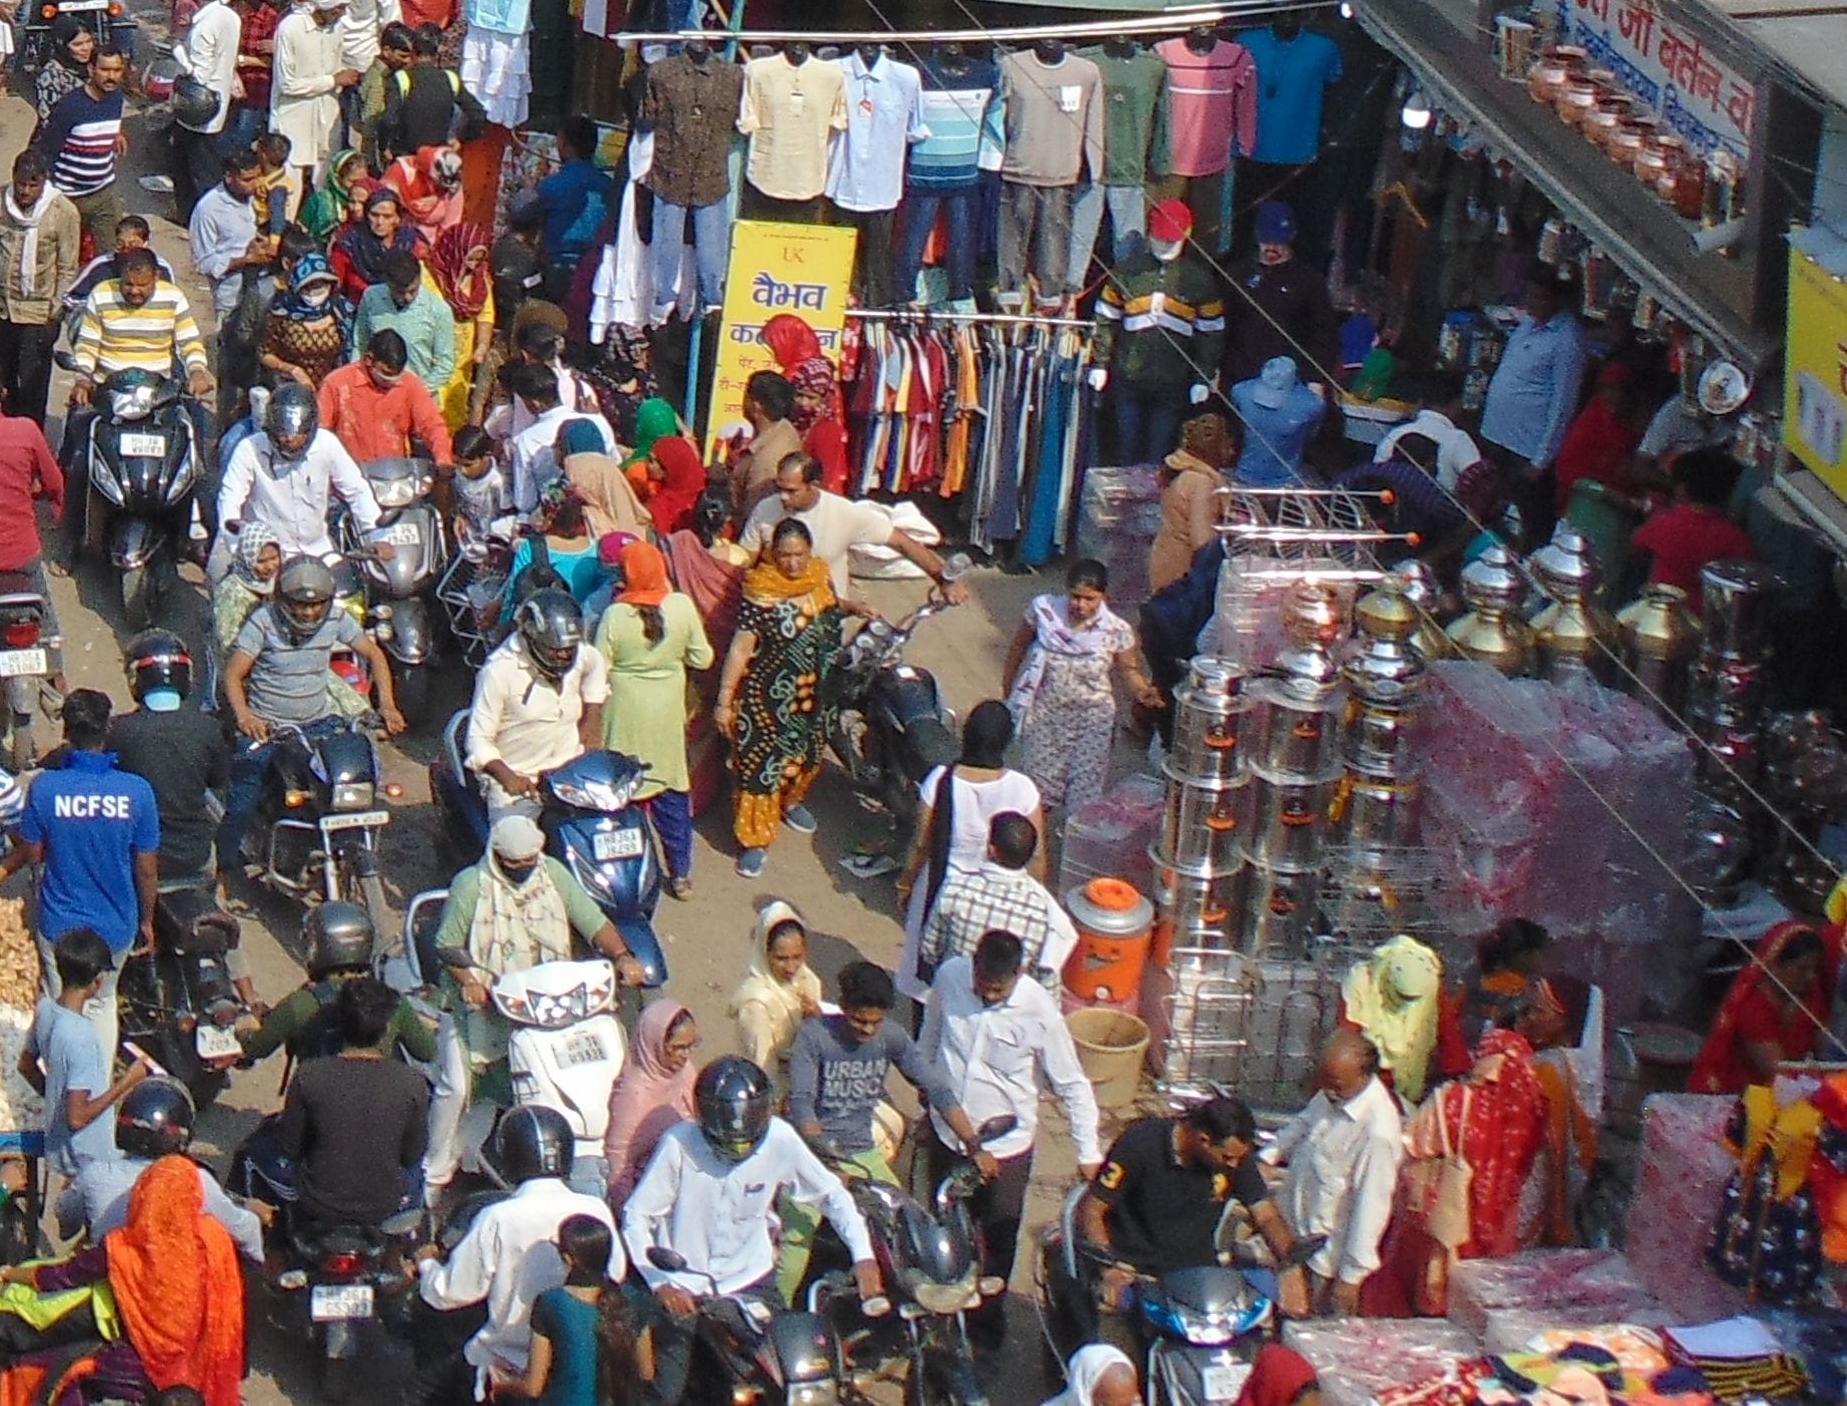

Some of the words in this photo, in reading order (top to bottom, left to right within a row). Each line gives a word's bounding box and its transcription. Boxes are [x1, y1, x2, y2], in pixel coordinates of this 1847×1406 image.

[751, 271, 828, 312] वैभव
[55, 794, 131, 819] NCFSE
[824, 1057, 886, 1079] URBAN
[1099, 1162, 1124, 1190] 3
